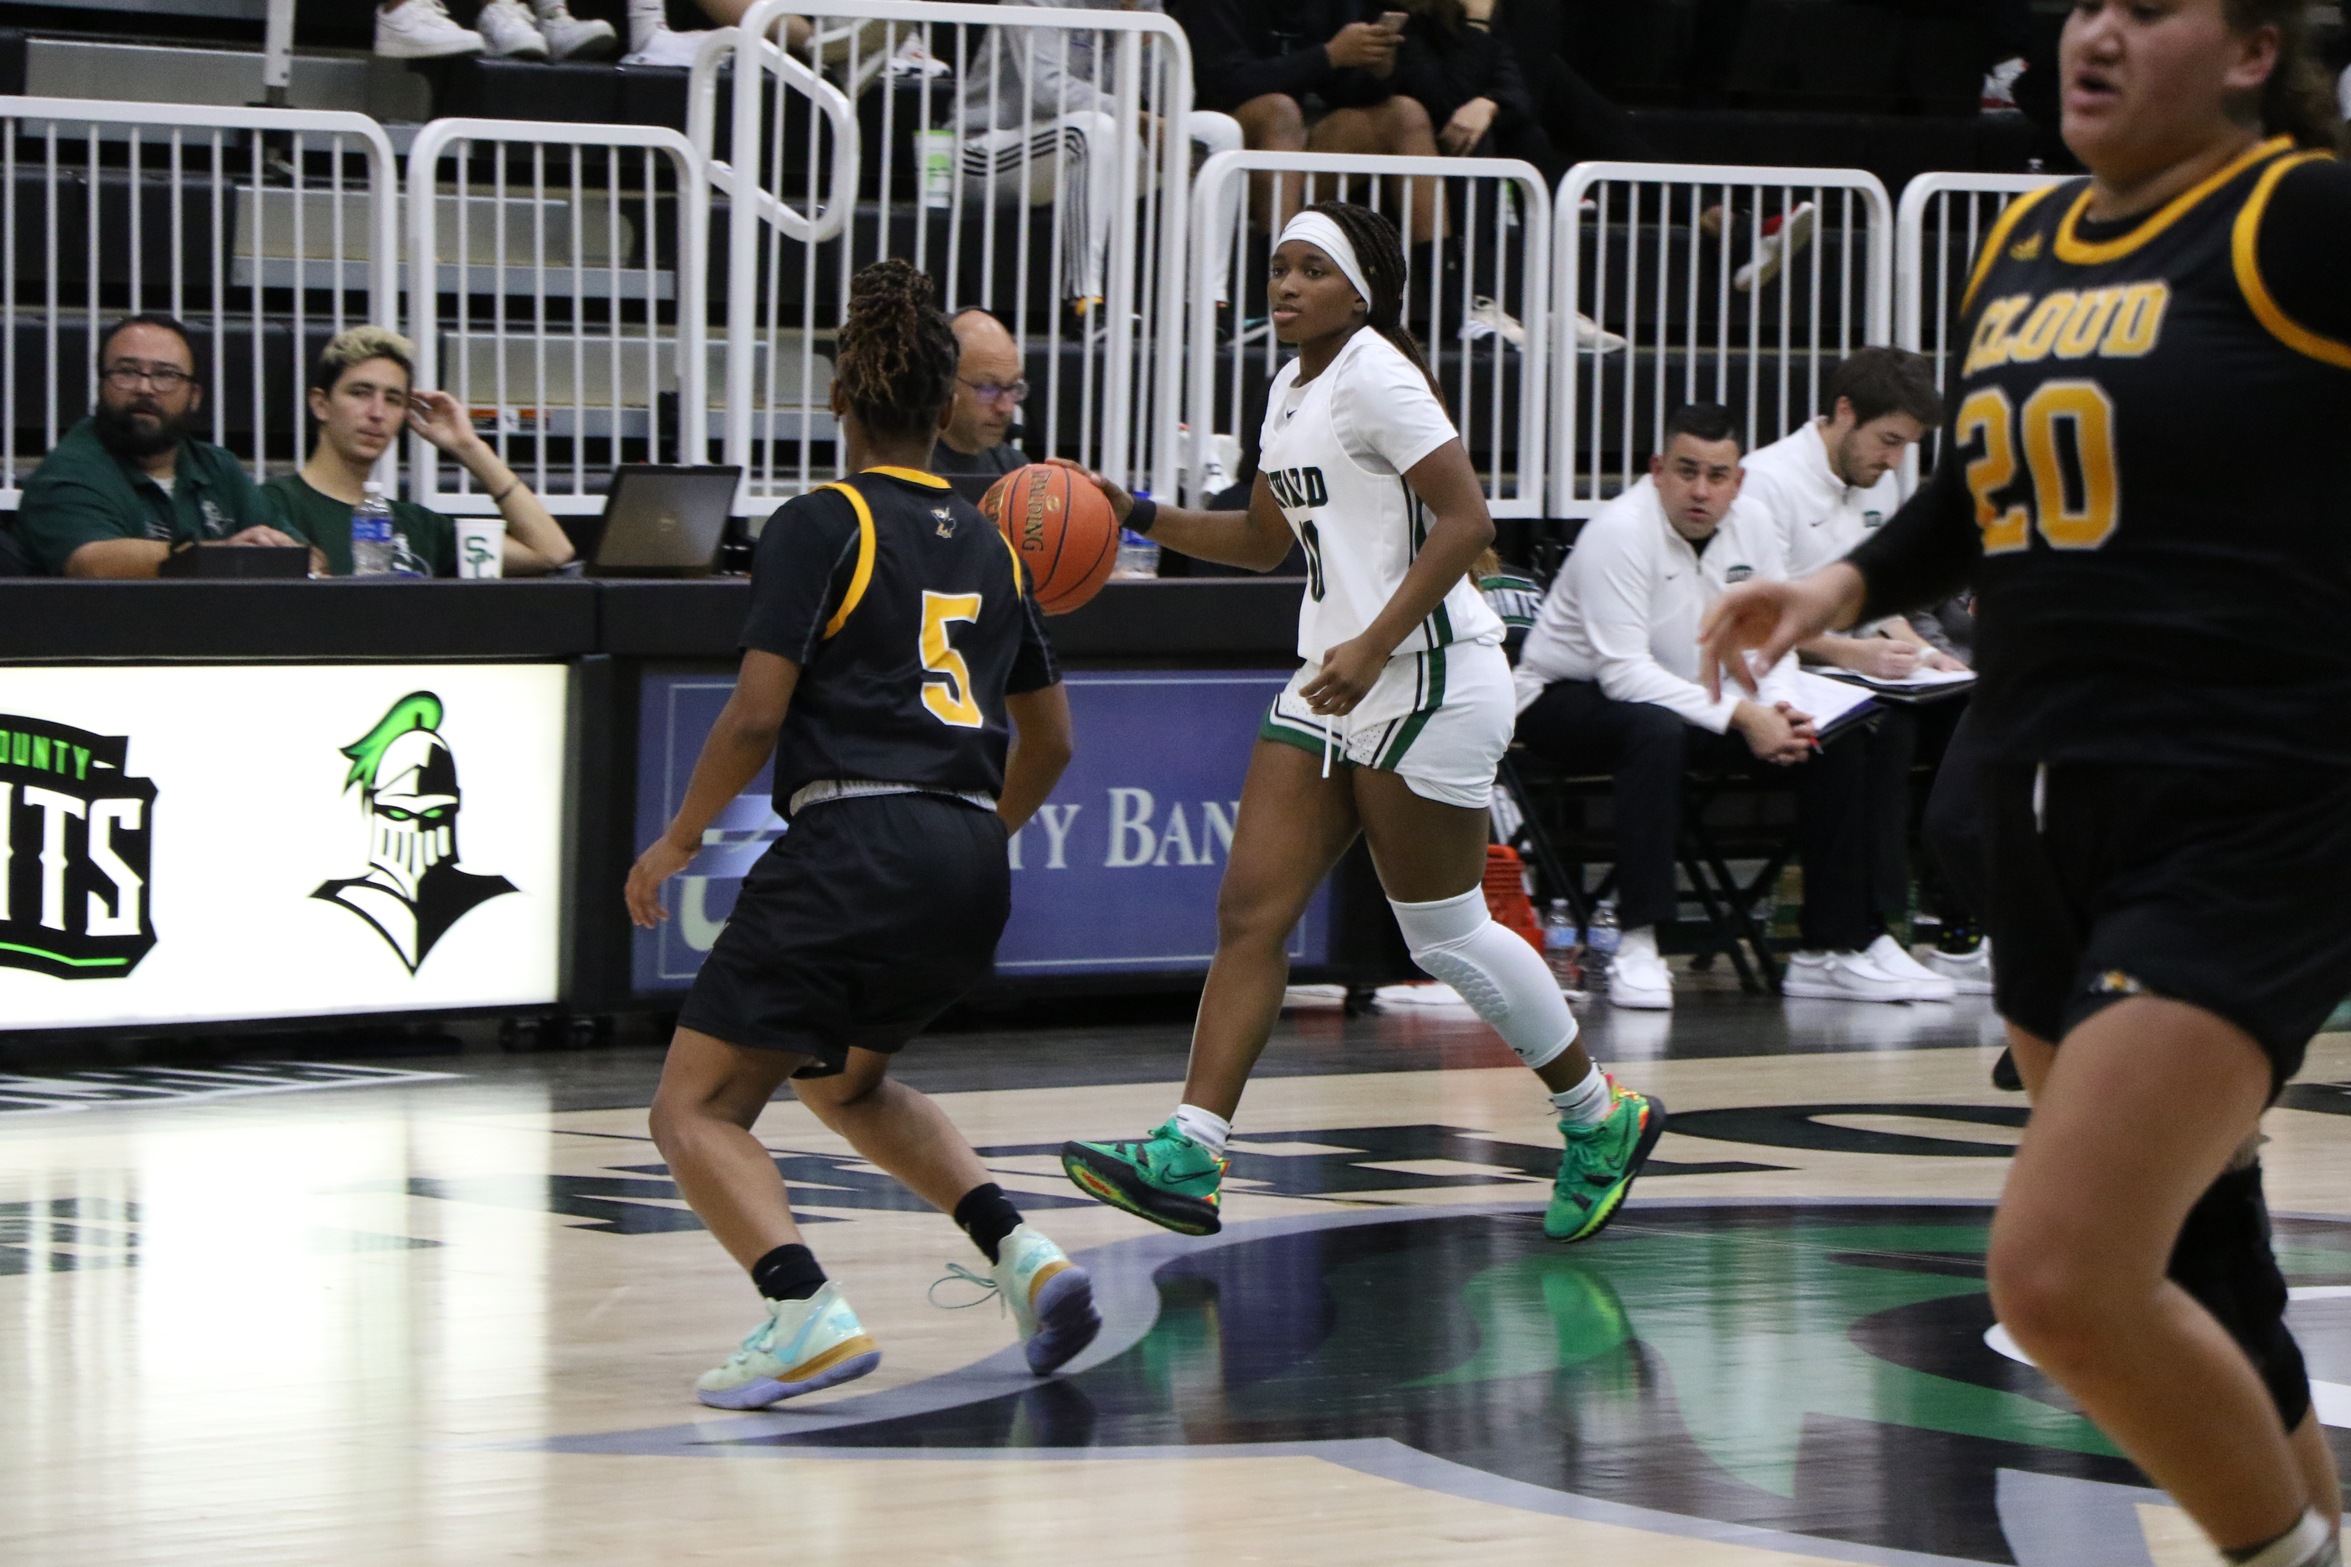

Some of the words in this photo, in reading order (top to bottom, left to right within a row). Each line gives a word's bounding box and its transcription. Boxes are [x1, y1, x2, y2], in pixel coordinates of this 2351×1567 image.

[1962, 279, 2171, 379] CLOUD
[1955, 379, 2119, 556] 20
[918, 588, 984, 729] 5
